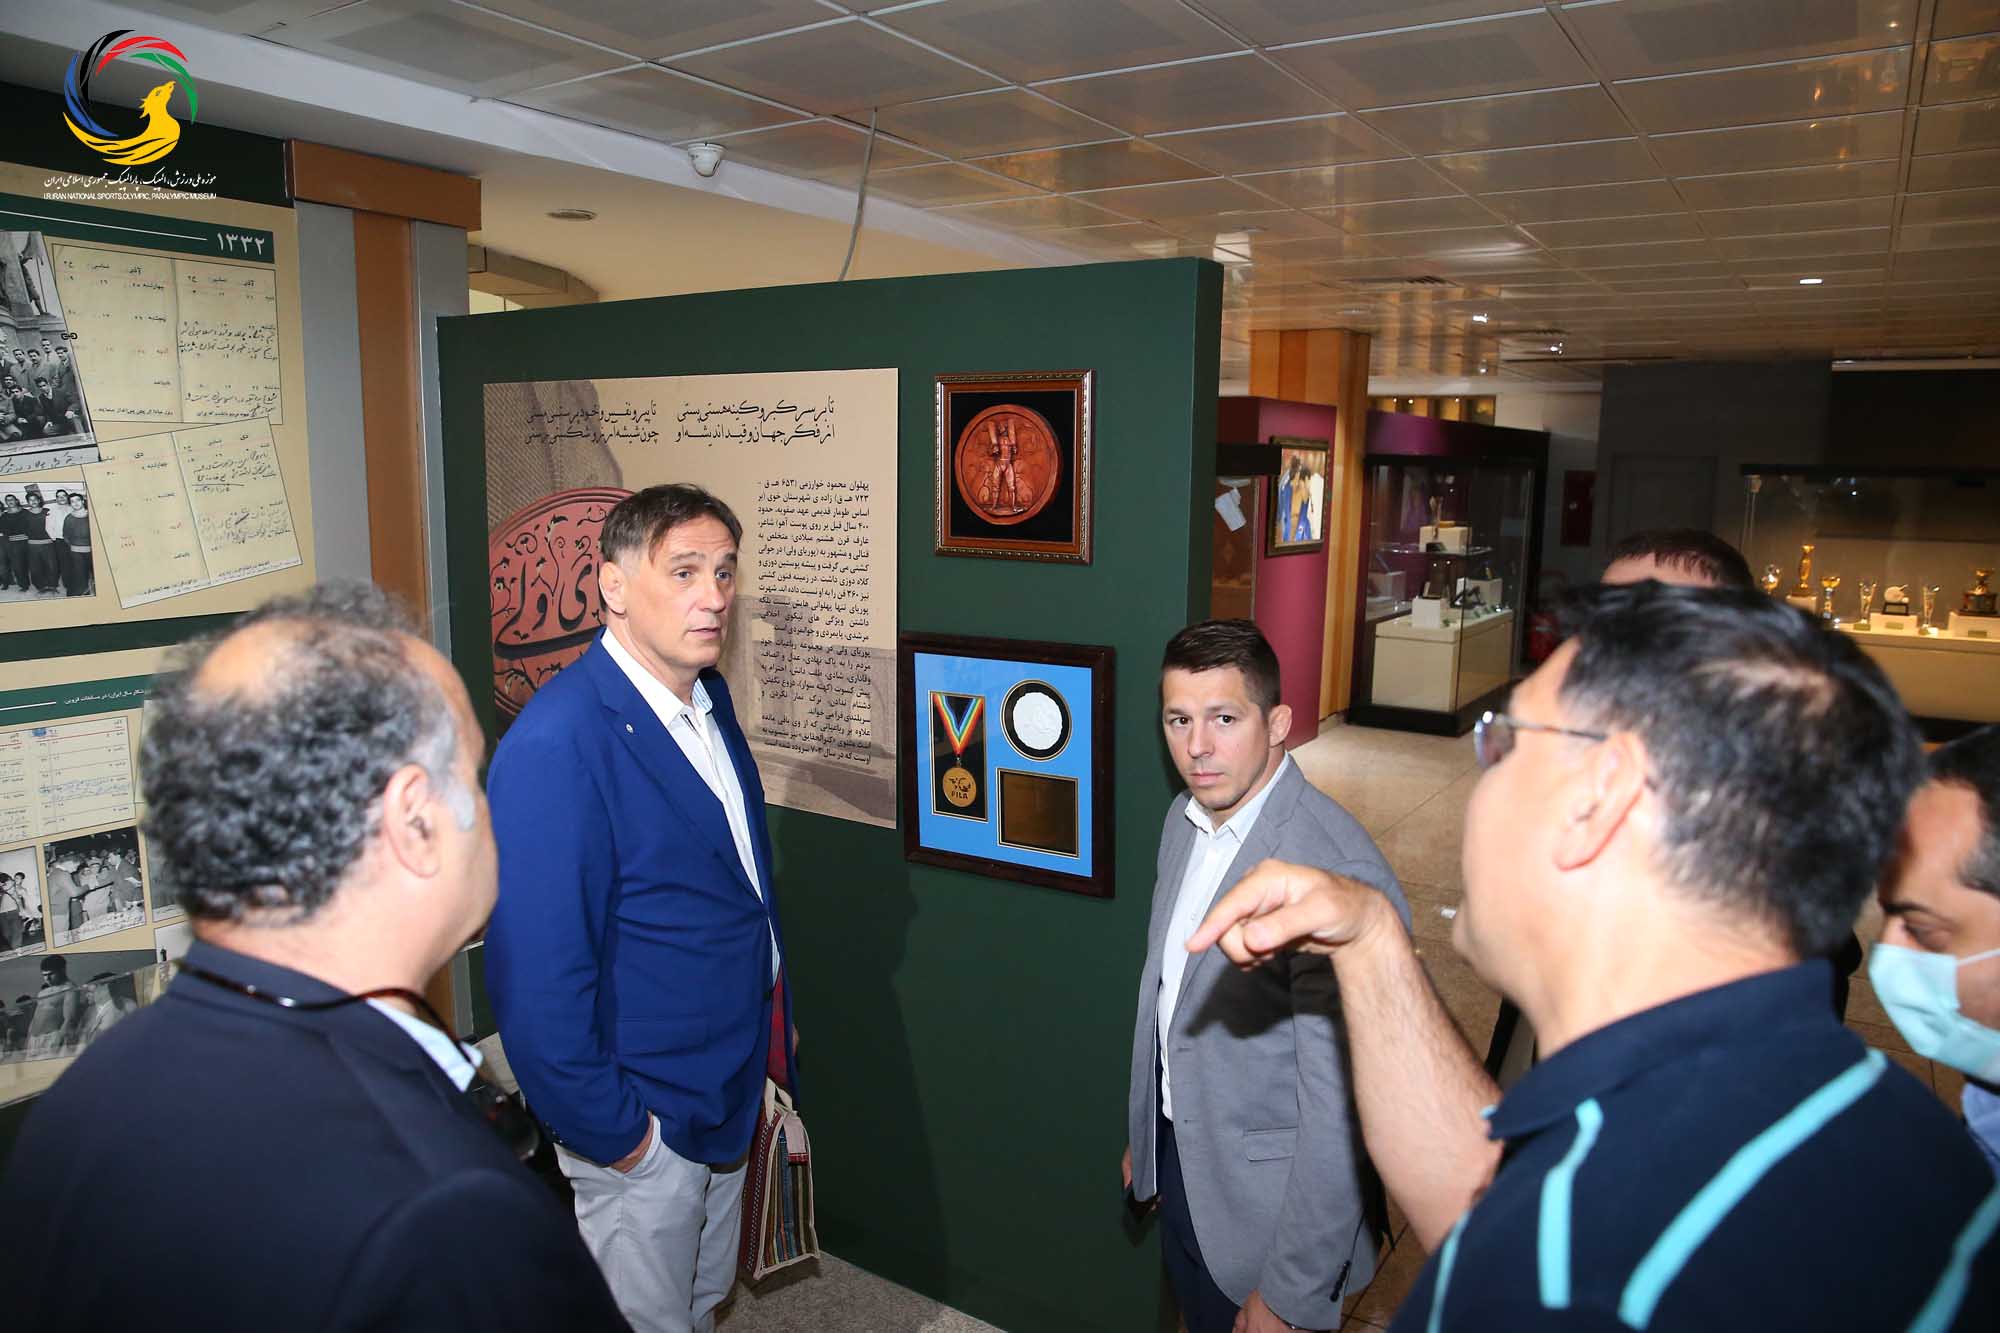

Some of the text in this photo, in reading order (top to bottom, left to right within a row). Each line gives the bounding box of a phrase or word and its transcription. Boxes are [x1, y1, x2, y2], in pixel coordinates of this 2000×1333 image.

[217, 232, 265, 256] ۱۳۳۲
[762, 399, 798, 422] کبر
[753, 420, 785, 443] جهان
[784, 423, 821, 446] فکر
[799, 479, 824, 491] خوارزمی
[826, 480, 847, 491] محمود
[849, 480, 869, 491] پهلوان
[811, 507, 831, 518] قدیمی
[832, 507, 850, 518] طومار
[851, 507, 870, 519] اساس
[843, 521, 857, 532] سال
[837, 536, 850, 546] قرن
[852, 536, 869, 547] عارف
[826, 549, 848, 559] مشهور
[849, 563, 870, 574] کشتی
[758, 570, 776, 580] کشتی
[856, 577, 869, 586] کلاه
[848, 603, 869, 616] پوریای
[848, 617, 870, 628] داشتن
[836, 645, 848, 656] ولی
[850, 647, 871, 659] پوریای
[855, 661, 871, 672] مردم
